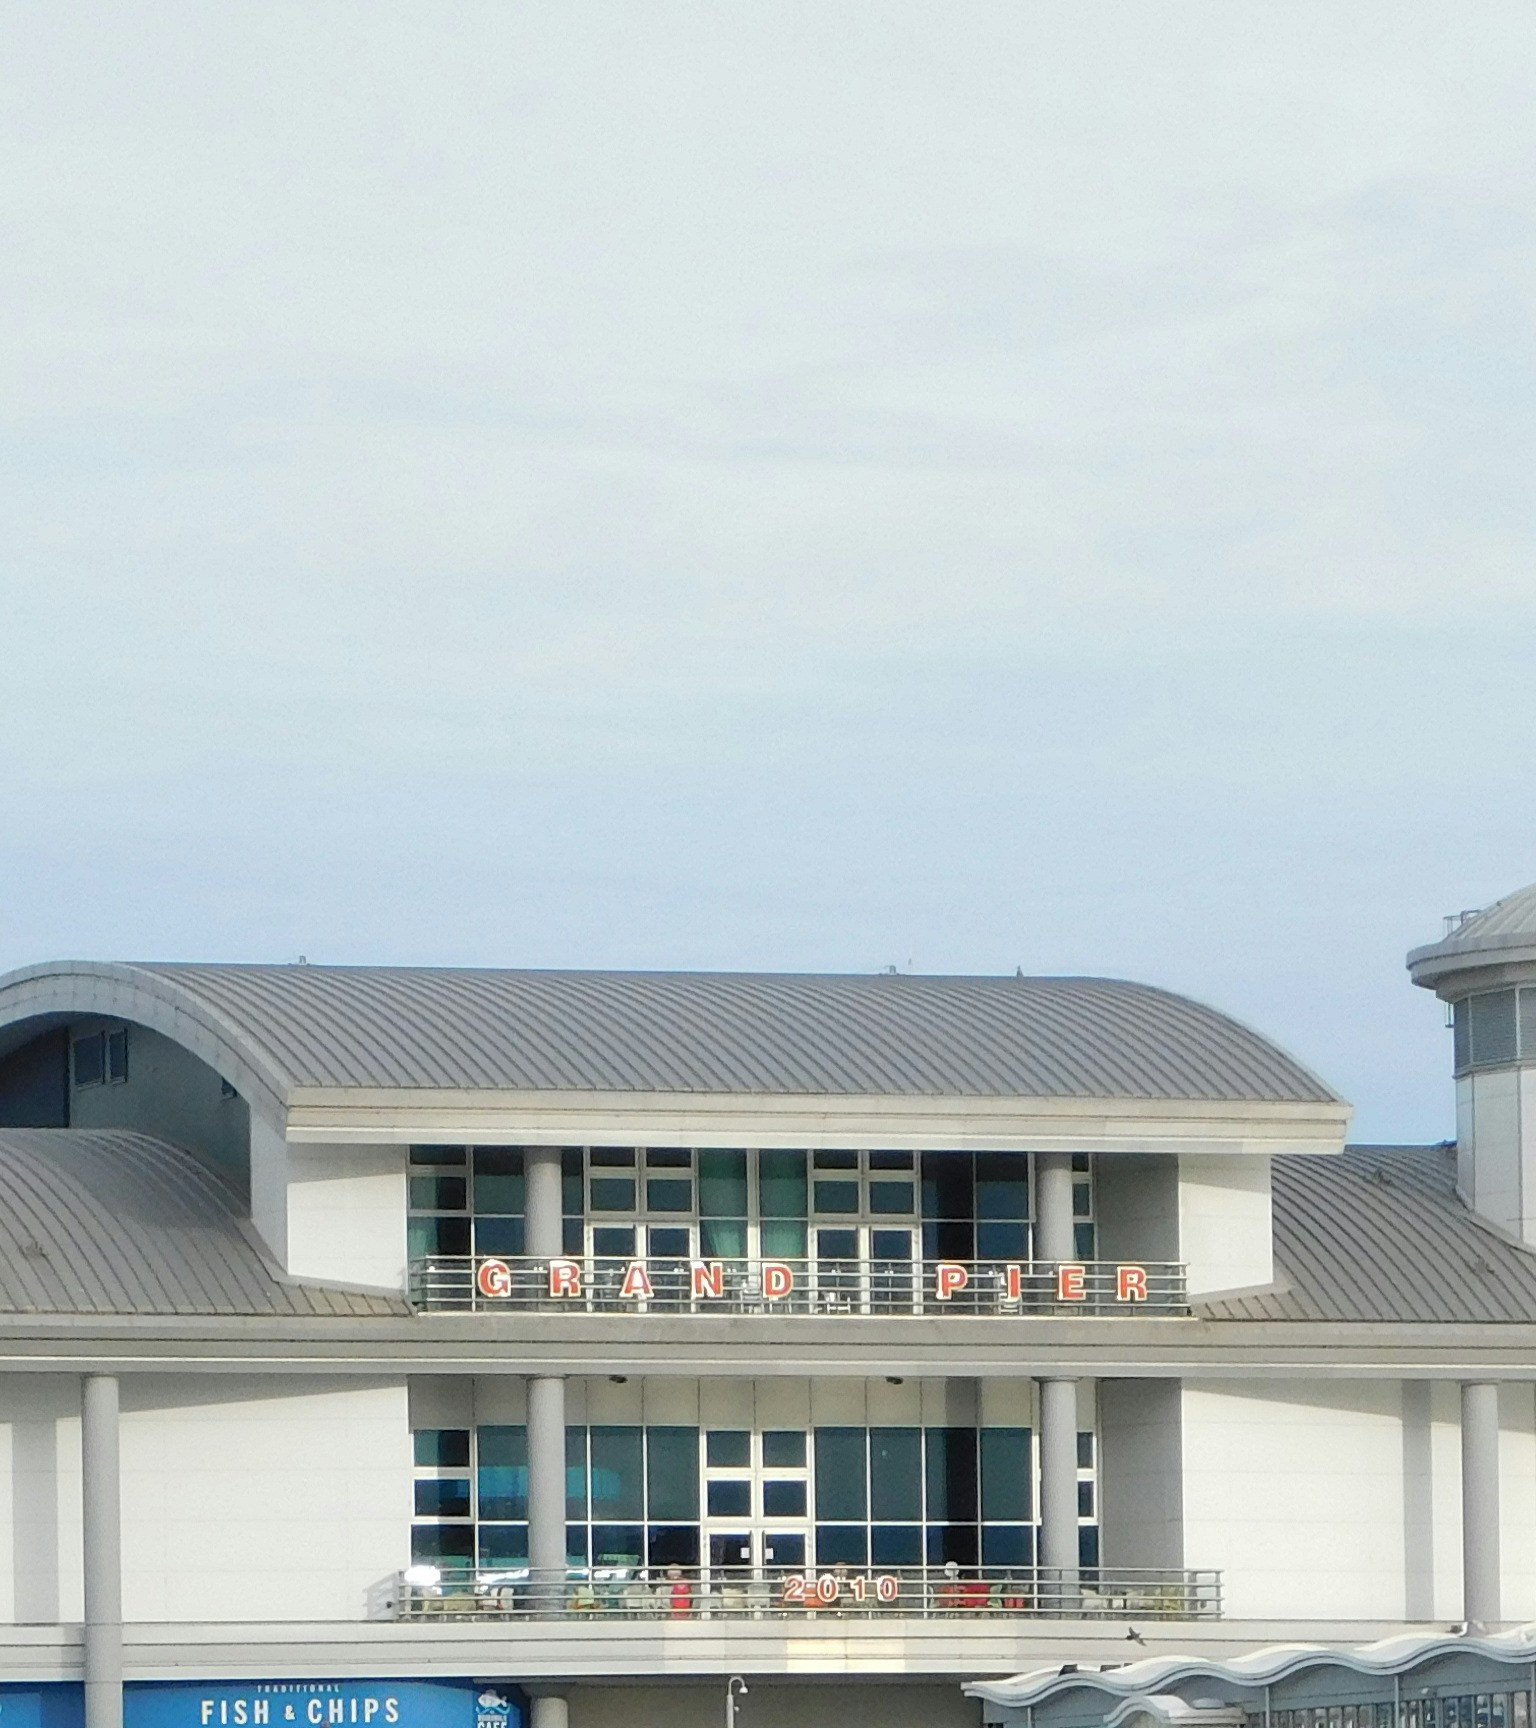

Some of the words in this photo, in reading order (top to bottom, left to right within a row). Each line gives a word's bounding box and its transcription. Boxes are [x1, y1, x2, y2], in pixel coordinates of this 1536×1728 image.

[477, 1258, 794, 1299] GRAND
[935, 1264, 1148, 1301] PIER
[784, 1573, 899, 1603] 2010
[257, 1684, 340, 1693] TRADITIONAL
[201, 1700, 269, 1725] FISH
[284, 1704, 296, 1721] &
[307, 1698, 399, 1724] CHIPS
